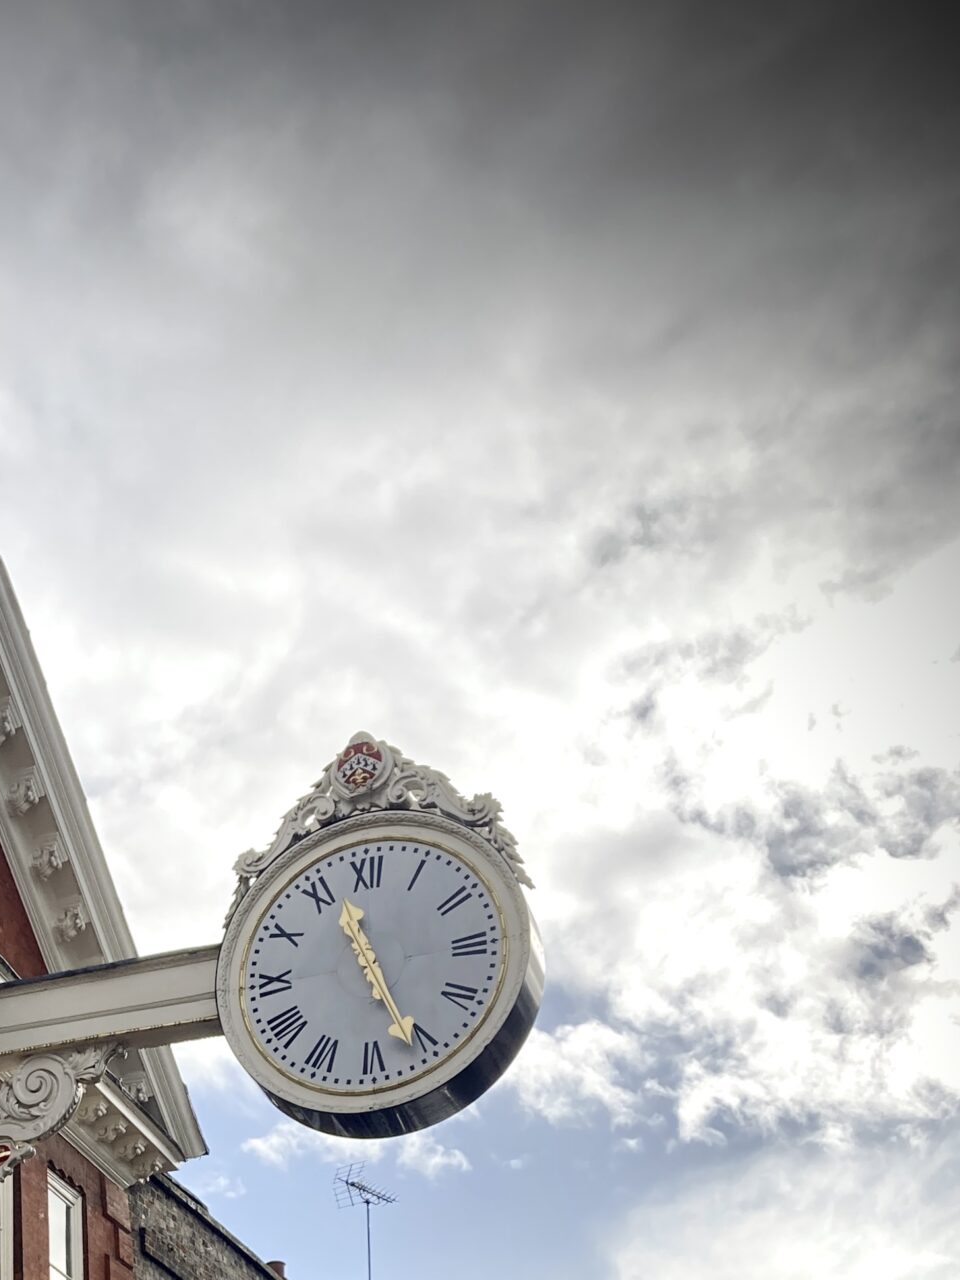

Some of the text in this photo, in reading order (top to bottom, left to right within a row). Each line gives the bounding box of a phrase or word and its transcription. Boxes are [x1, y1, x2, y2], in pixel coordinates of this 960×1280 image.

[350, 855, 384, 893] XII
[301, 876, 335, 914] XI
[437, 885, 472, 916] II
[269, 923, 305, 948] X
[451, 930, 488, 958] III
[258, 968, 293, 999] IX
[440, 981, 479, 1012] IV
[266, 1004, 309, 1050] VIII
[412, 1022, 439, 1054] V
[304, 1033, 339, 1074] VII
[362, 1039, 386, 1076] VI
